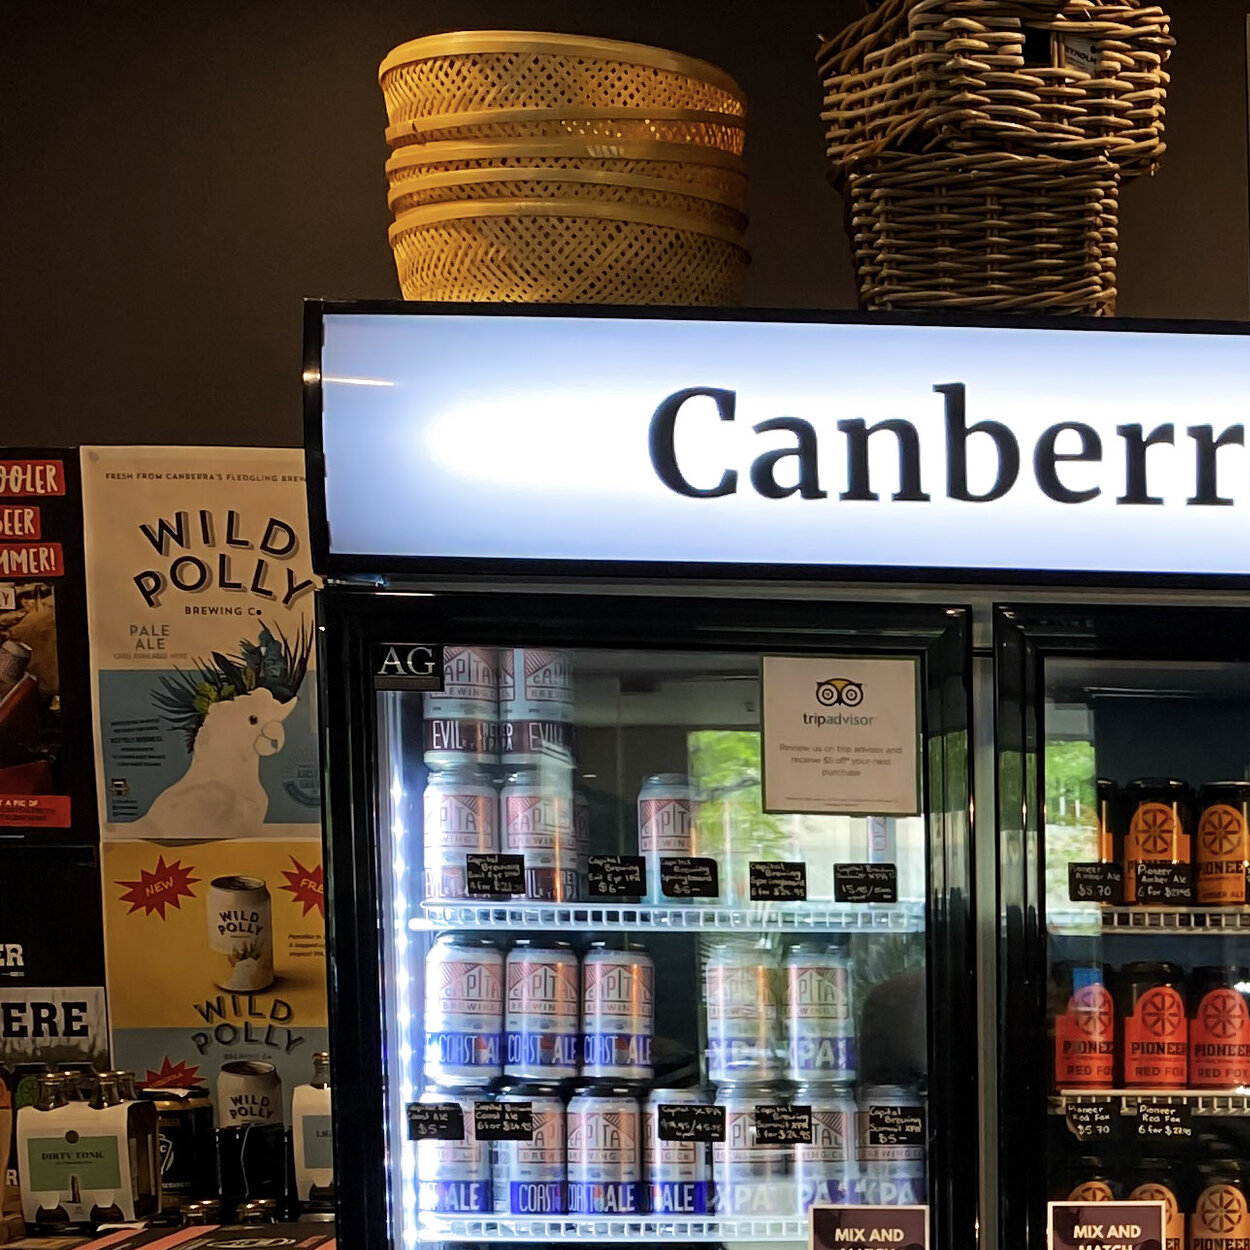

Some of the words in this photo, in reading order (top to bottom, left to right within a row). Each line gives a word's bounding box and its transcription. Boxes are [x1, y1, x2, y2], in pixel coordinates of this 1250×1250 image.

[105, 472, 133, 481] FRESH
[136, 473, 162, 481] FROM
[166, 473, 223, 482] CANBERRA'S
[226, 474, 278, 482] FLEDGLING
[139, 509, 299, 560] WILD
[133, 553, 317, 609] POLLY
[185, 606, 242, 616] BREWING
[130, 624, 170, 637] PALE
[136, 638, 165, 650] ALE
[377, 646, 436, 675] AG
[803, 713, 874, 728] tripadvisor
[432, 720, 463, 750] EVIL
[822, 769, 861, 778] purchase
[145, 877, 175, 897] NEW
[219, 910, 259, 923] WILD
[217, 922, 263, 936] POLLY
[193, 995, 295, 1023] WILD
[191, 1022, 305, 1055] POLLY
[1194, 1043, 1250, 1057] PIONEER
[229, 1095, 270, 1107] WILD
[229, 1106, 274, 1120] POLLY
[835, 1228, 866, 1242] MIX
[869, 1228, 904, 1242] AND
[1073, 1225, 1104, 1239] MIX
[1107, 1225, 1141, 1239] AND
[1193, 1238, 1250, 1250] PIONEER
